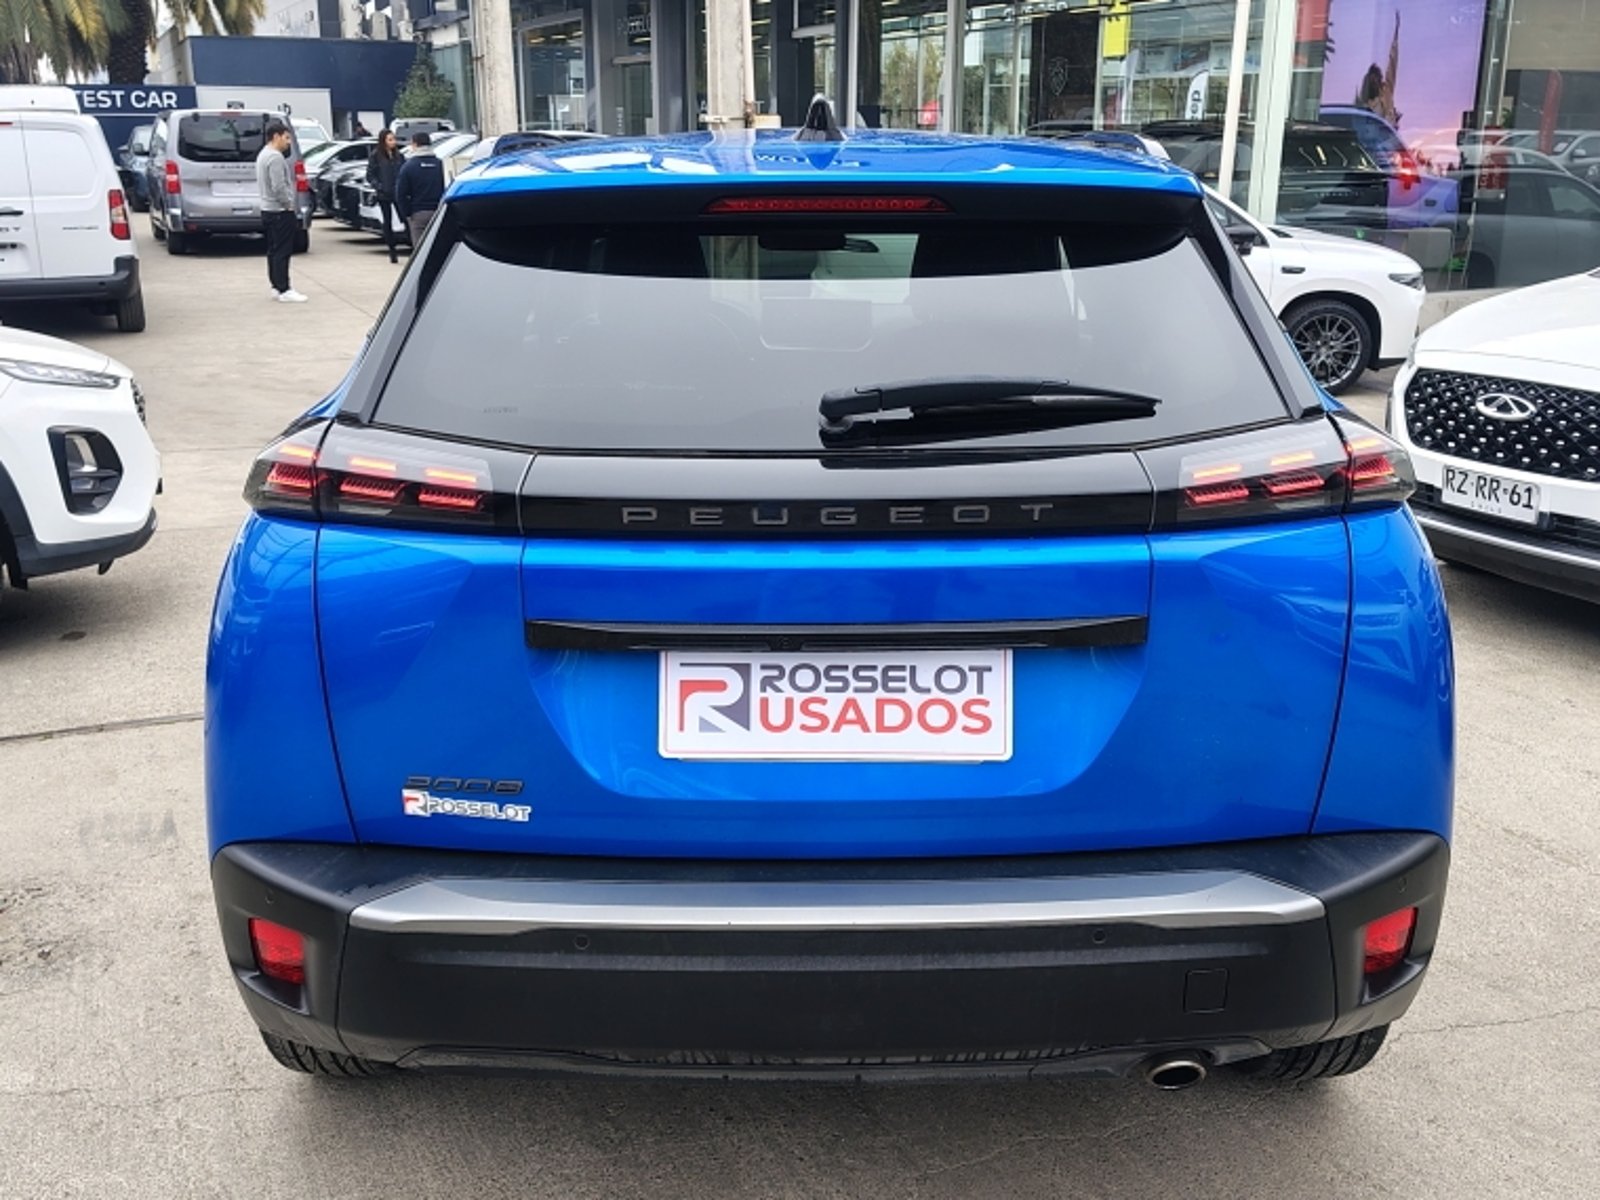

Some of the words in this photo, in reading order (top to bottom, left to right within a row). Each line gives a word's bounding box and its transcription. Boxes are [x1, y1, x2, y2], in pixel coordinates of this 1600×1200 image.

[130, 90, 178, 108] CAR
[621, 503, 1053, 525] PEUGEOT
[759, 663, 993, 696] ROSSELOT
[759, 697, 993, 735] USADOS
[405, 776, 523, 794] 2008
[430, 798, 530, 820] ROSSELOT
